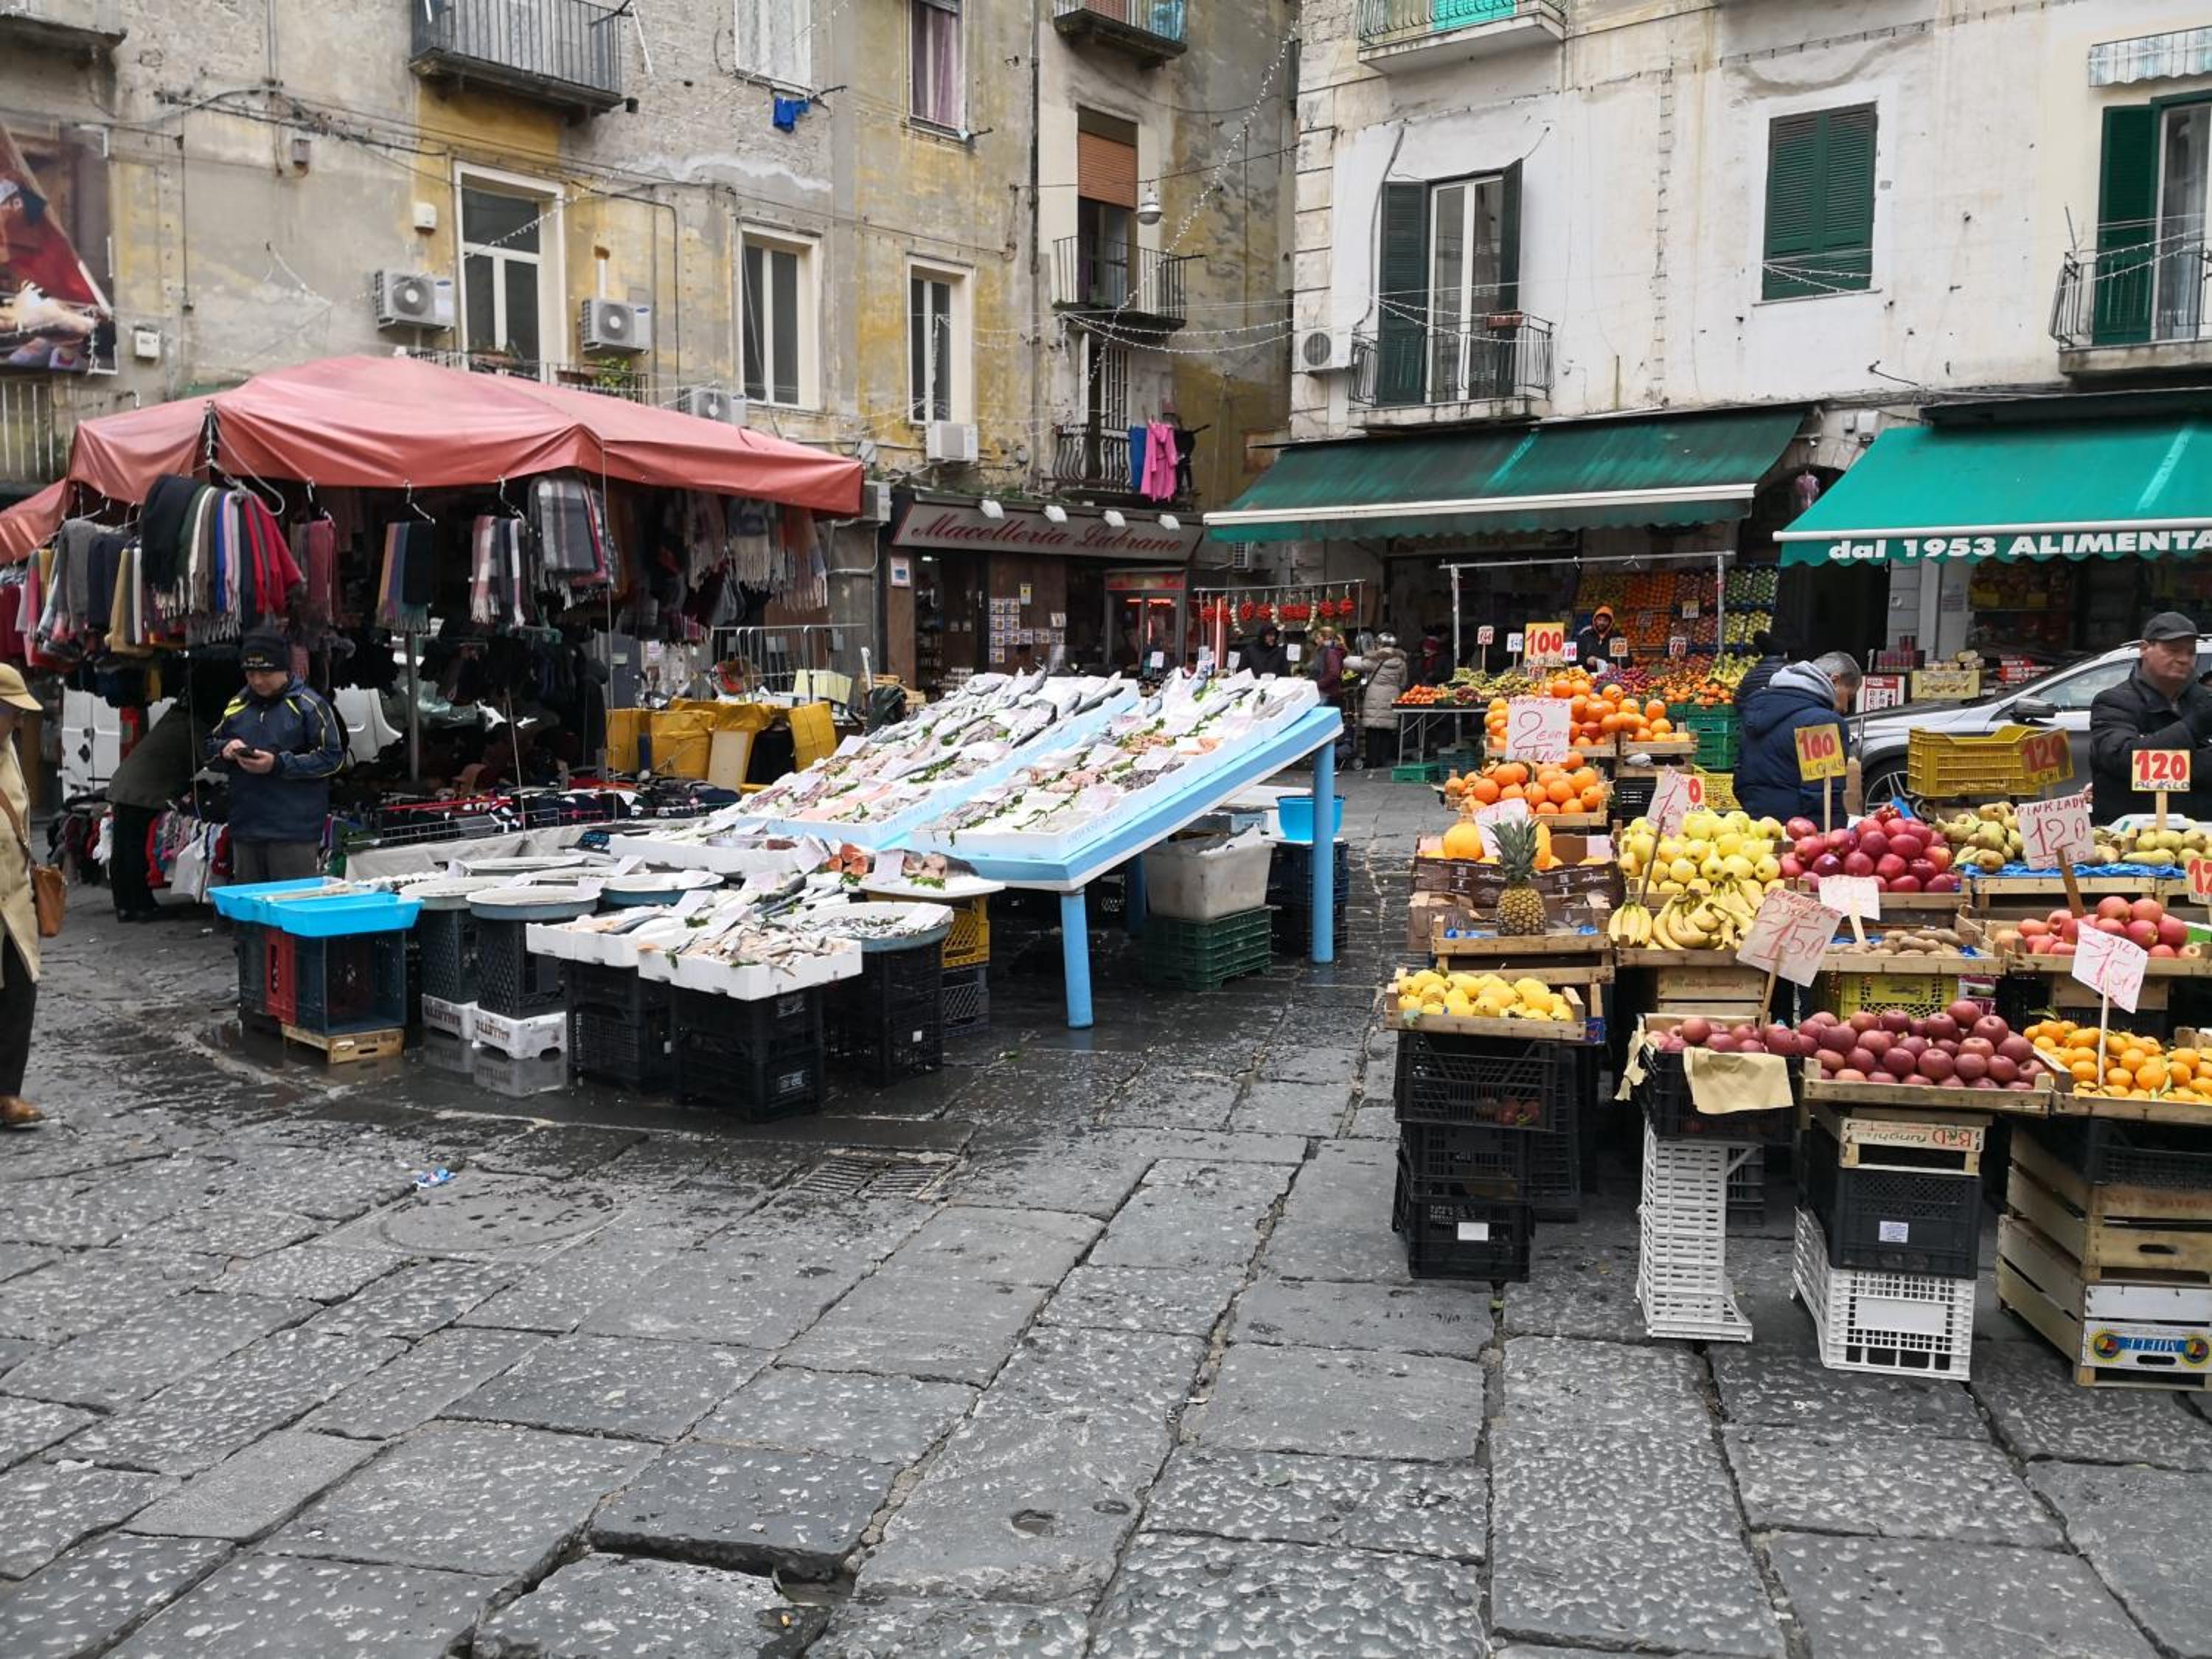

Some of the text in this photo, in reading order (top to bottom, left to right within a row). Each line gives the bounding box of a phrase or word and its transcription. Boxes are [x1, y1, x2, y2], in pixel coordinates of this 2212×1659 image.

[911, 512, 1181, 552] Macelleria Lubrano
[1829, 539, 1887, 560] dal
[1903, 537, 1996, 558] 1953
[1526, 629, 1562, 655] 100
[1798, 731, 1835, 762] 100
[2022, 734, 2067, 773] 120
[2135, 750, 2188, 782] 120
[2017, 796, 2086, 815] PINK LADY
[2030, 817, 2085, 858] 120
